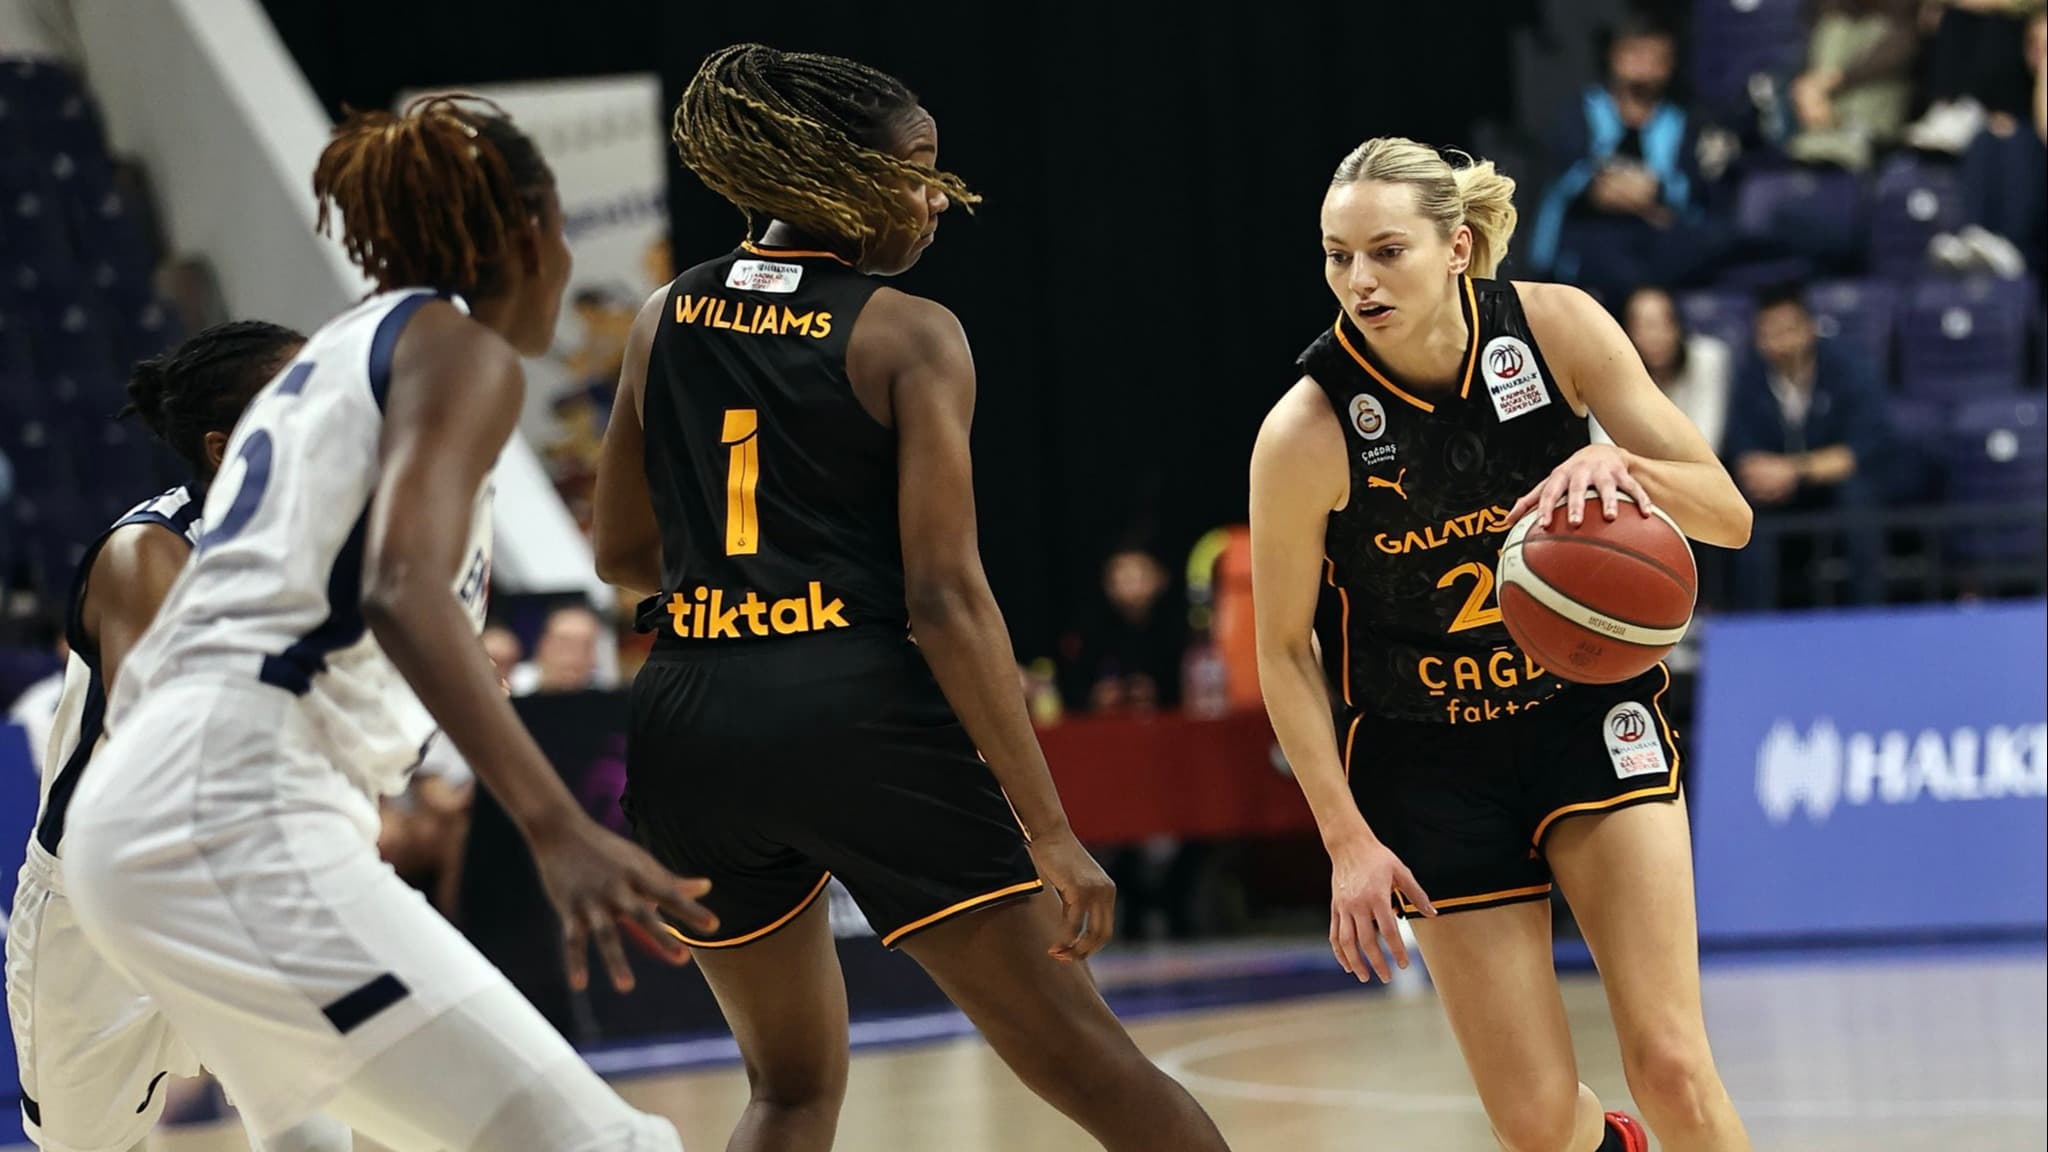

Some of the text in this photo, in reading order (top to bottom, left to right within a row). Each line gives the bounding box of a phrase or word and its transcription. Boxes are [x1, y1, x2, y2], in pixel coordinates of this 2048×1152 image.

[674, 294, 833, 339] WILLIAMS
[720, 408, 760, 557] 1
[1374, 505, 1513, 555] GALATAS
[667, 580, 850, 640] tiktak
[1436, 549, 1504, 634] 2
[1418, 646, 1547, 696] ÇAĞD
